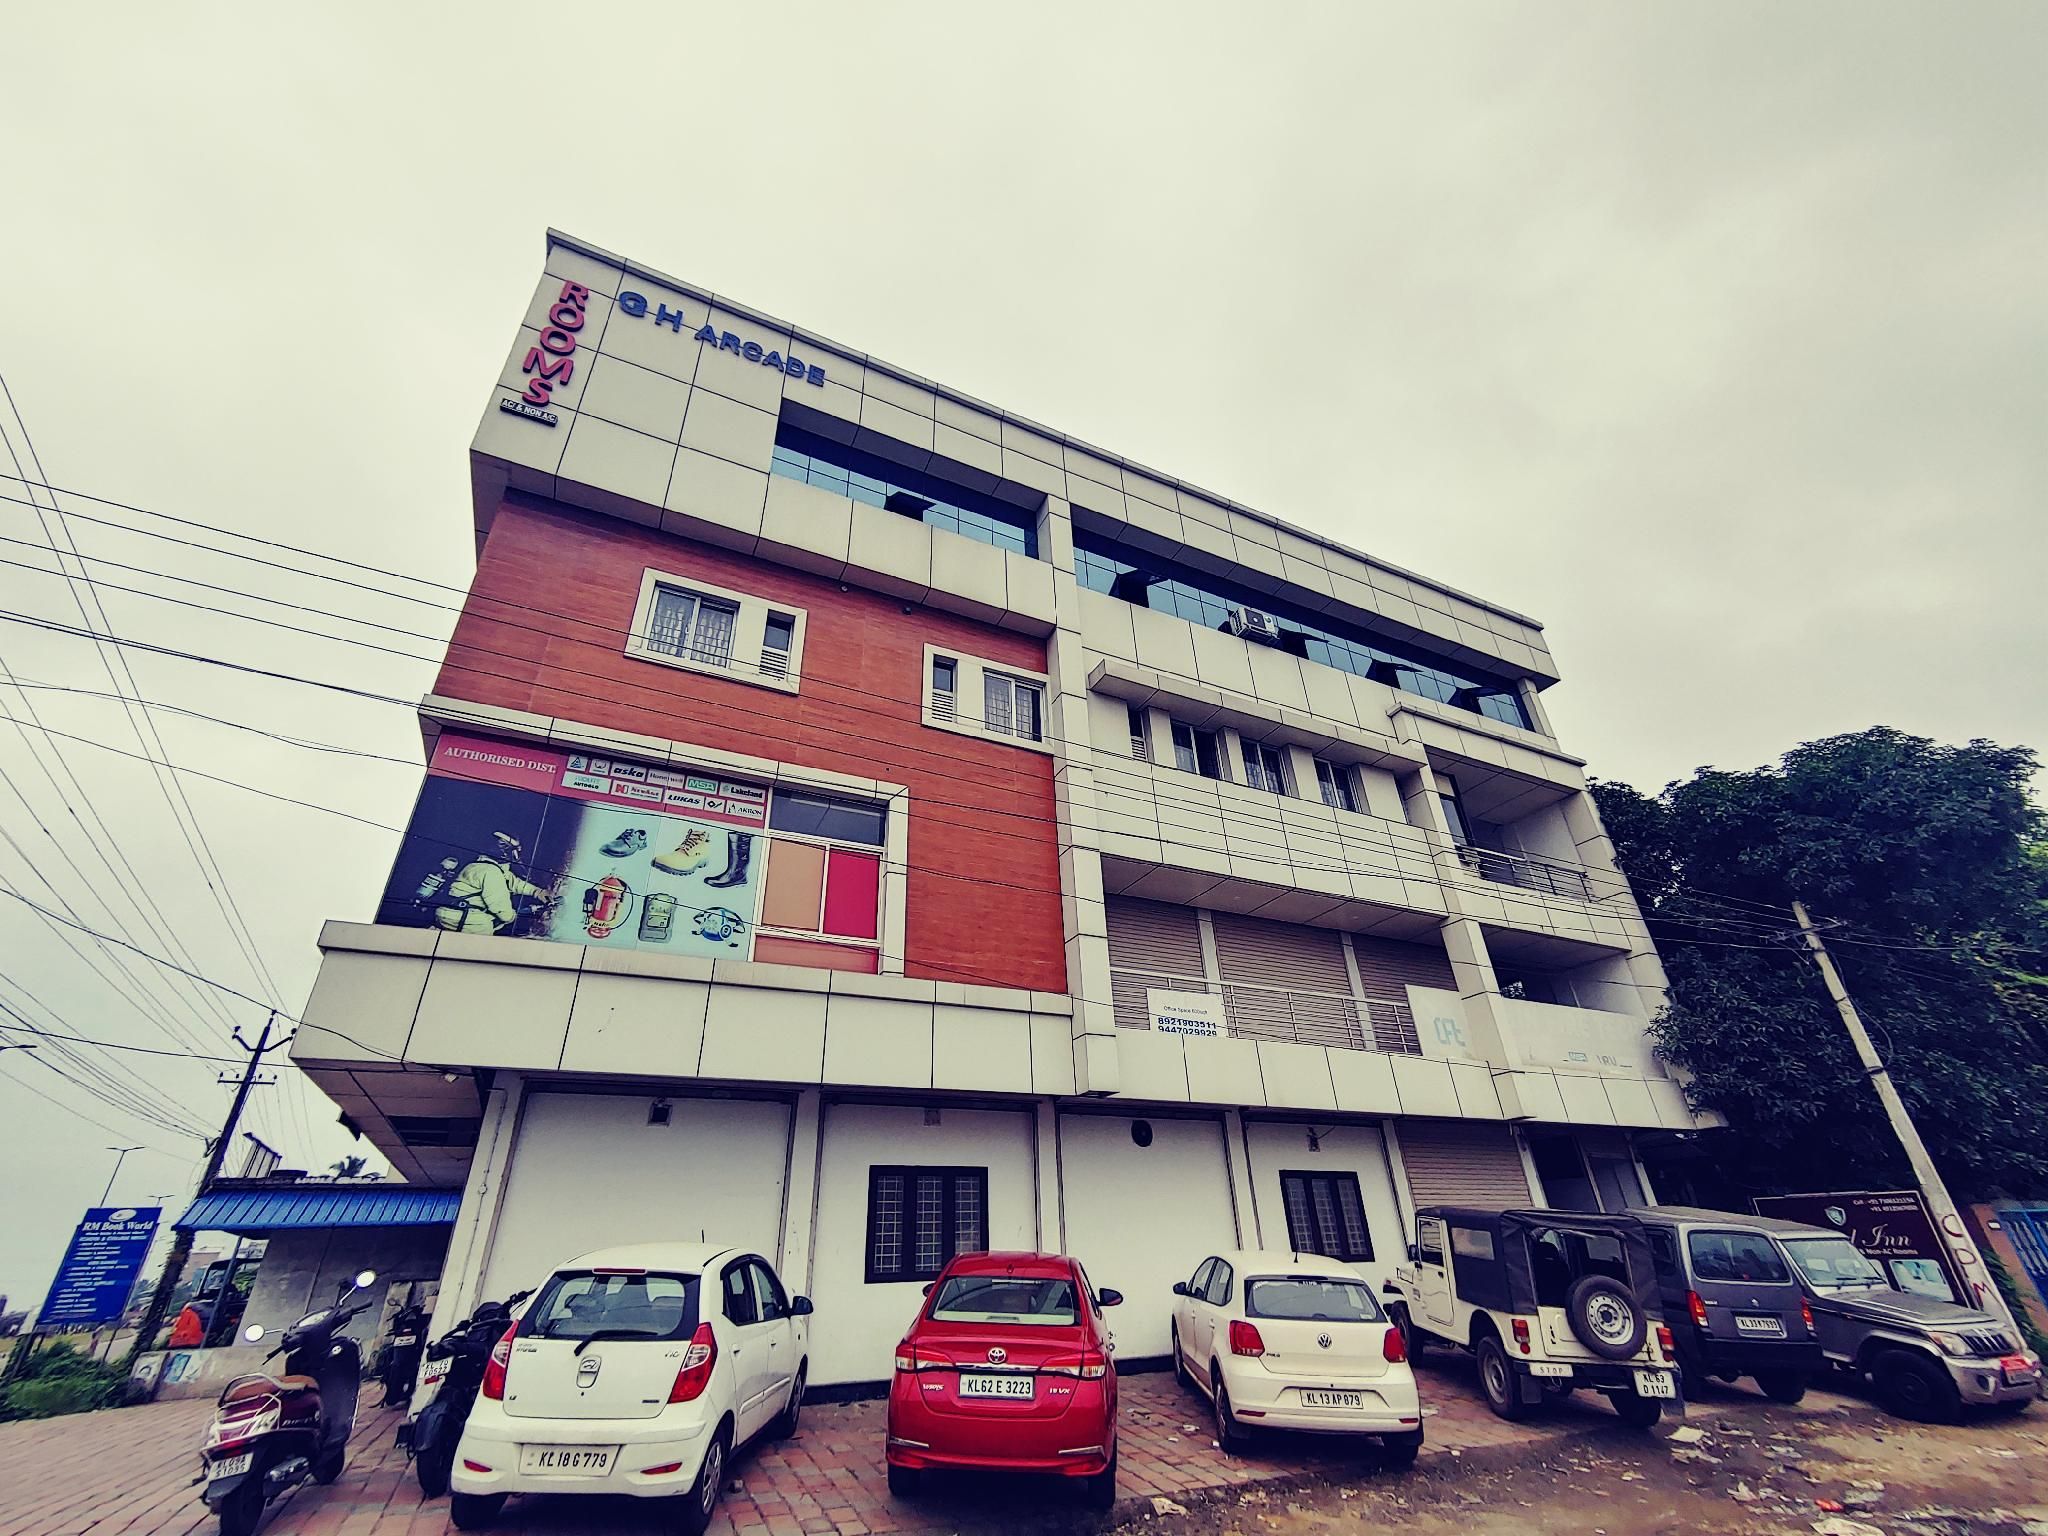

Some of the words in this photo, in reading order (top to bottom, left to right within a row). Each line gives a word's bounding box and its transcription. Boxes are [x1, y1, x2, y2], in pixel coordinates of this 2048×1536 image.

[521, 280, 589, 407] ROOMS
[694, 324, 826, 387] ARCADE
[524, 406, 542, 417] NON
[444, 746, 526, 769] AUTHORISED
[527, 760, 556, 774] DIST.
[613, 767, 644, 778] aska
[688, 779, 715, 791] MSA
[730, 786, 763, 799] Lakeland
[667, 794, 701, 805] LUKAS
[737, 806, 762, 816] AKRON
[82, 1222, 100, 1231] RM
[127, 1221, 154, 1230] World
[1862, 1224, 1911, 1247] Inn
[967, 1379, 993, 1393] KL62
[997, 1380, 1003, 1393] E
[1005, 1381, 1031, 1394] 3223
[1320, 1393, 1330, 1404] 13
[1343, 1394, 1360, 1406] 879
[557, 1451, 571, 1467] 18
[583, 1452, 607, 1468] 779
